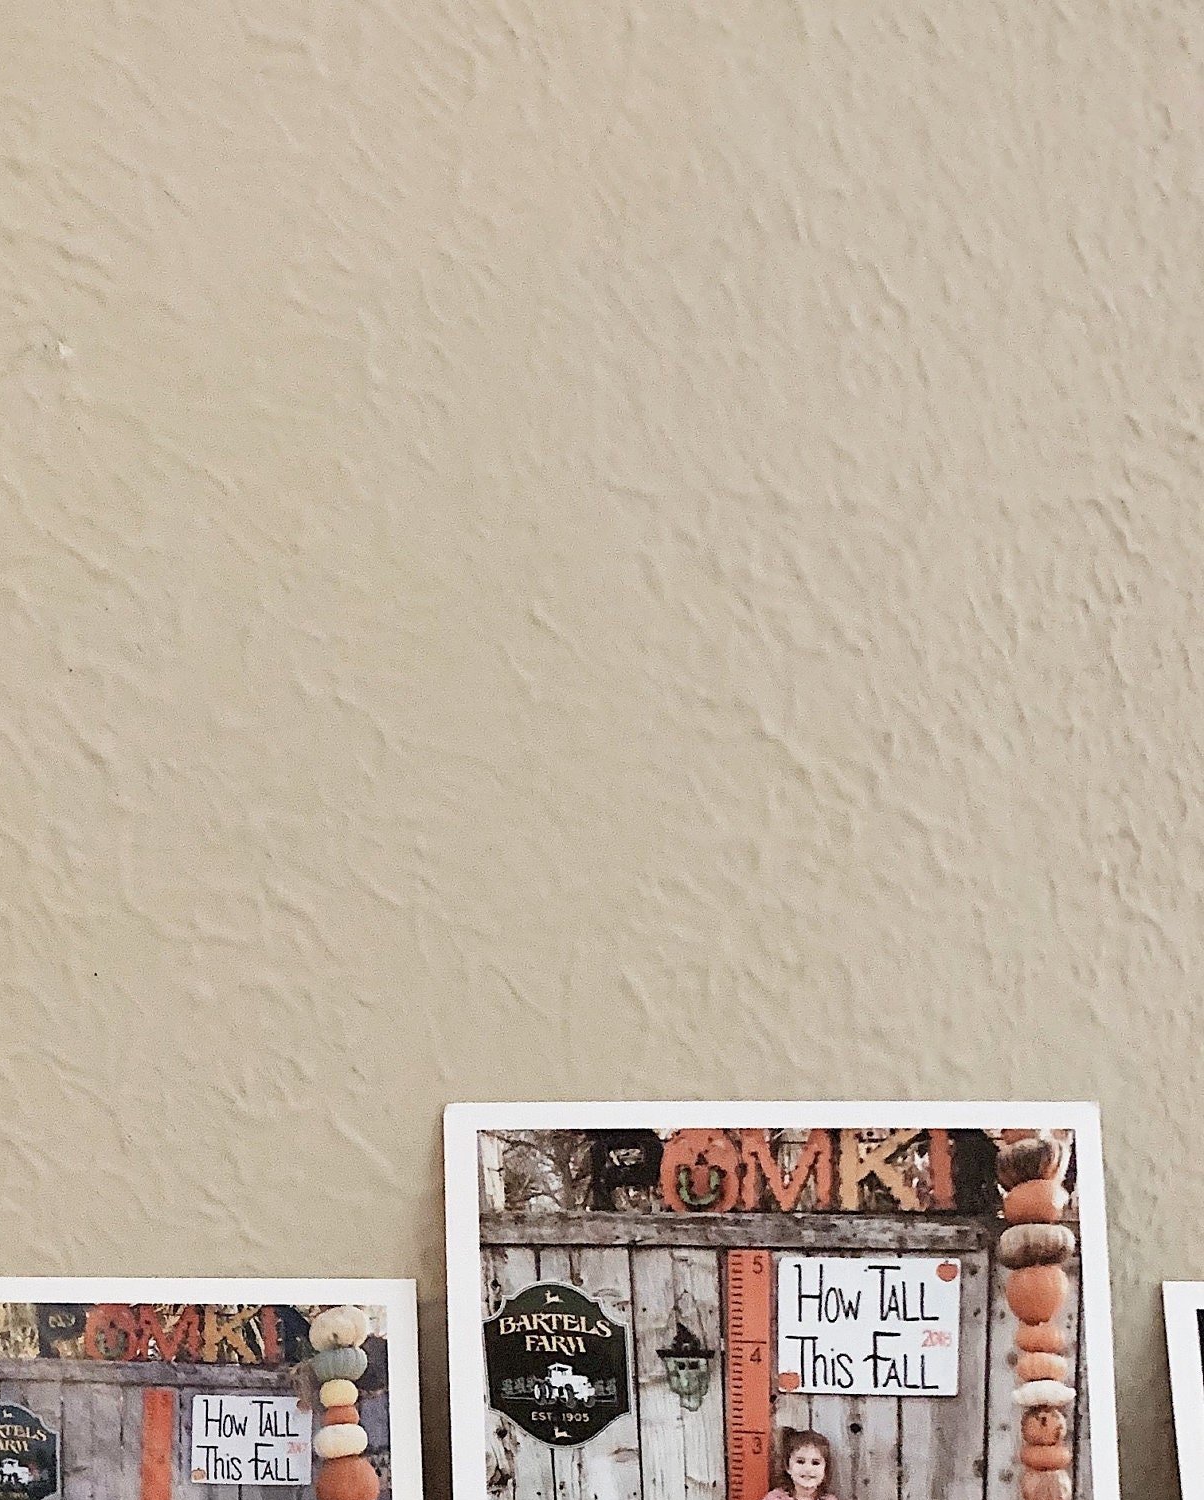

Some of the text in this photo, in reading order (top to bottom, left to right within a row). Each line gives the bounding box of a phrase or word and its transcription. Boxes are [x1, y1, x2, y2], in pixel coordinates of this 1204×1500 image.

[752, 1255, 763, 1274] 5
[793, 1263, 940, 1323] How TALL
[498, 1312, 612, 1338] BARTELS
[525, 1335, 587, 1357] FARM
[750, 1346, 762, 1365] 4
[785, 1330, 940, 1389] This FALL
[202, 1399, 299, 1438] How TALL
[561, 1412, 590, 1423] 1905
[752, 1436, 762, 1455] 3
[196, 1442, 299, 1481] This FALL
